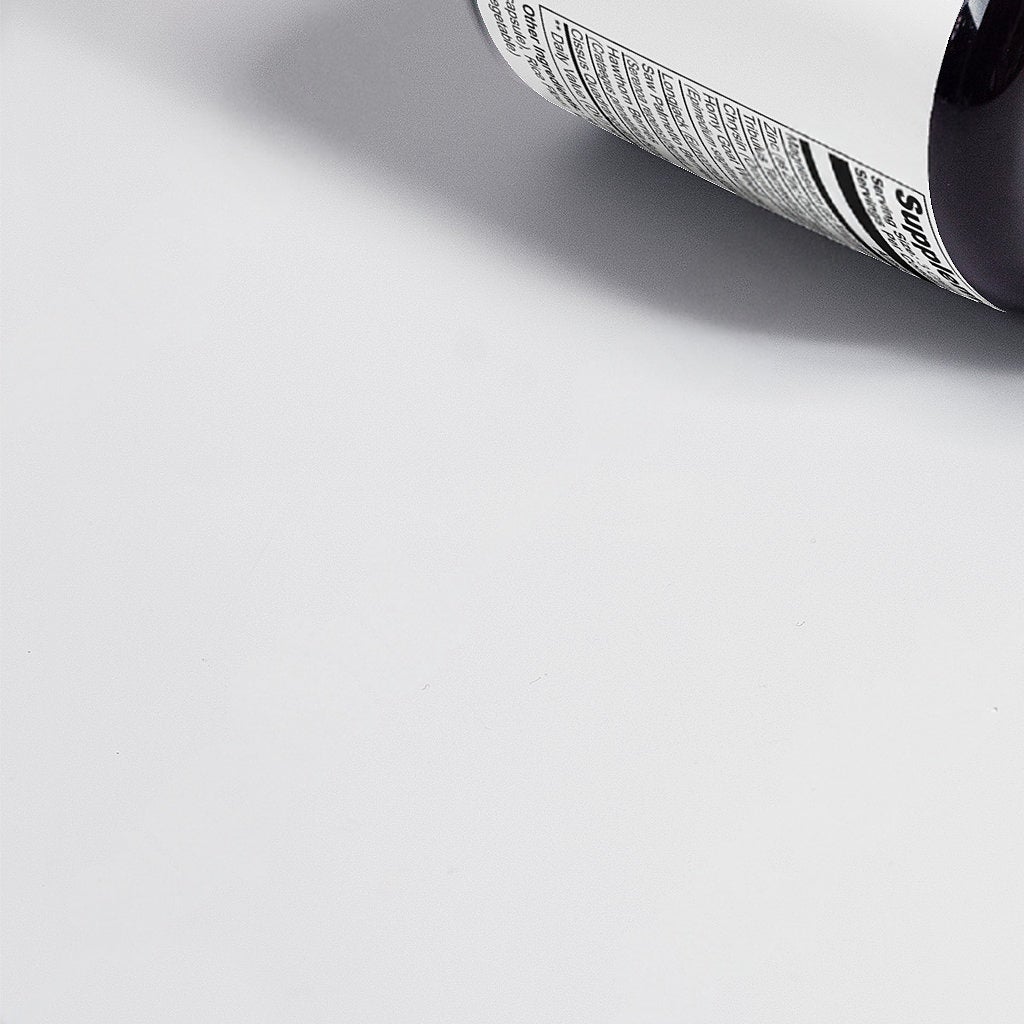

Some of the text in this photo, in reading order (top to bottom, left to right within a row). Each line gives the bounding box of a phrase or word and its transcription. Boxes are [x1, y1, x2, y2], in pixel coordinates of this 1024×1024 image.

[522, 4, 541, 45] Other
[550, 31, 570, 66] Daily
[563, 68, 587, 100] Value
[570, 27, 590, 71] Cissus
[606, 45, 634, 106] Hawthorn
[641, 62, 657, 94] Saw
[649, 93, 683, 147] Palmetto
[702, 91, 723, 134] Horny
[722, 102, 747, 152] Chrysin
[763, 120, 780, 152] Zinc
